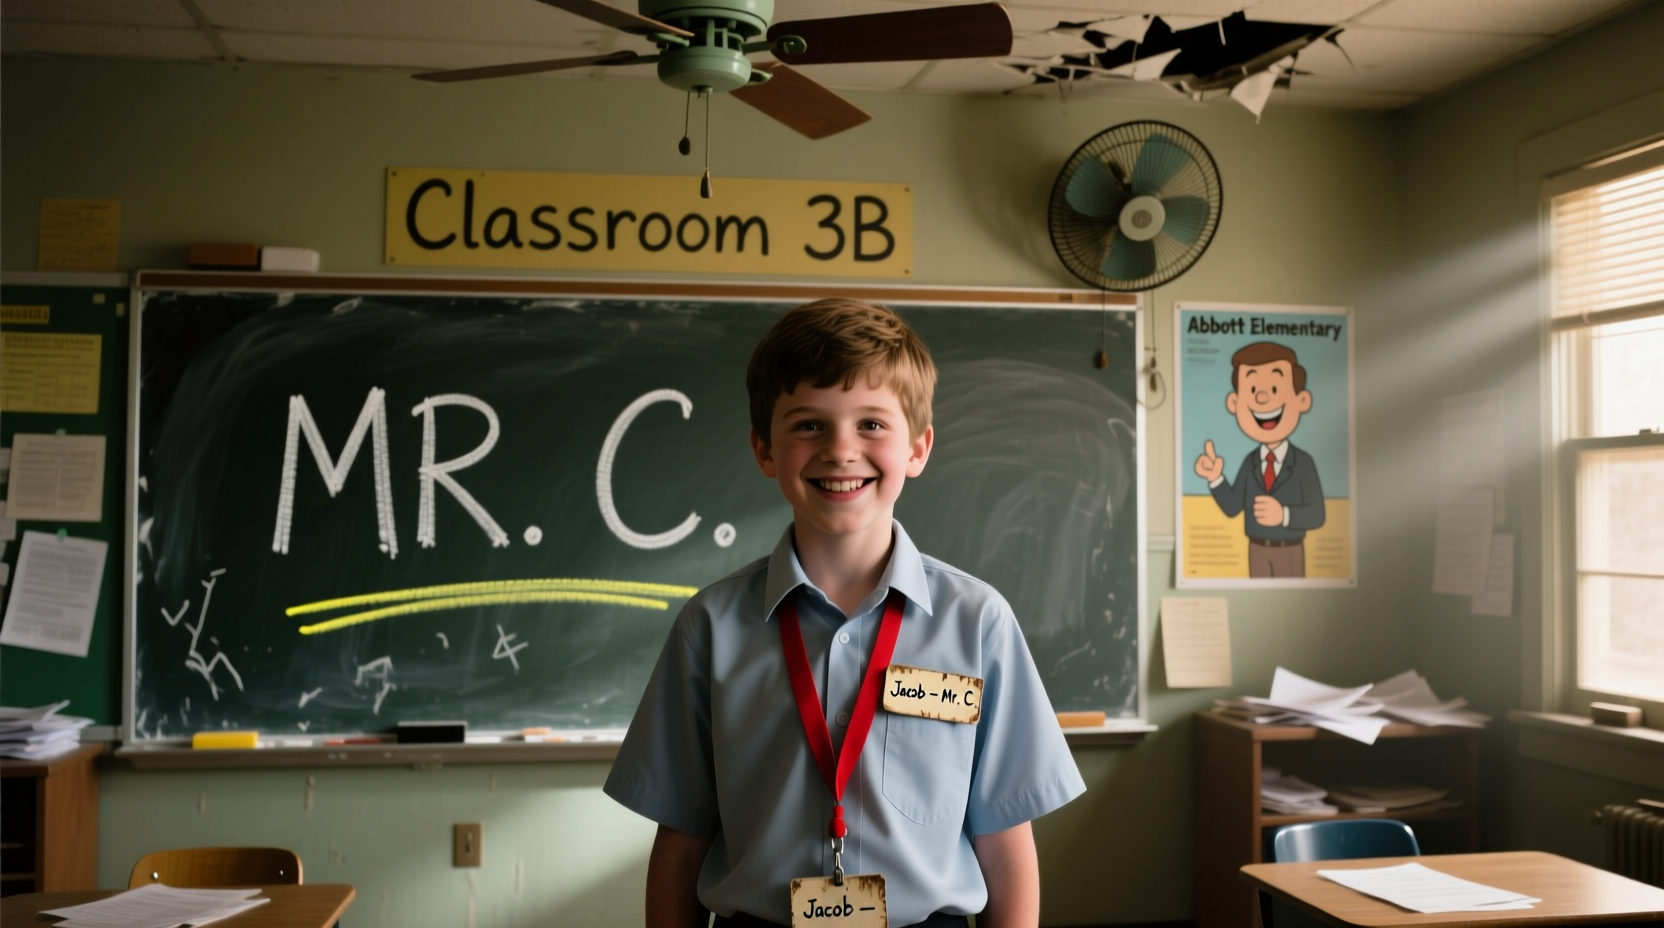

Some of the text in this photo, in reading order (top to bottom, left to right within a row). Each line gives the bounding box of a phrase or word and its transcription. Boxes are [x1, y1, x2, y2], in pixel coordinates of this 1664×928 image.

[406, 178, 895, 262] Classroom 3B
[1187, 315, 1342, 342] Abbott Elementary
[272, 386, 543, 559] MR.
[596, 388, 736, 549] C.
[890, 680, 926, 700] Jacob
[941, 688, 960, 706] Mr.
[803, 895, 854, 919] Jacob
